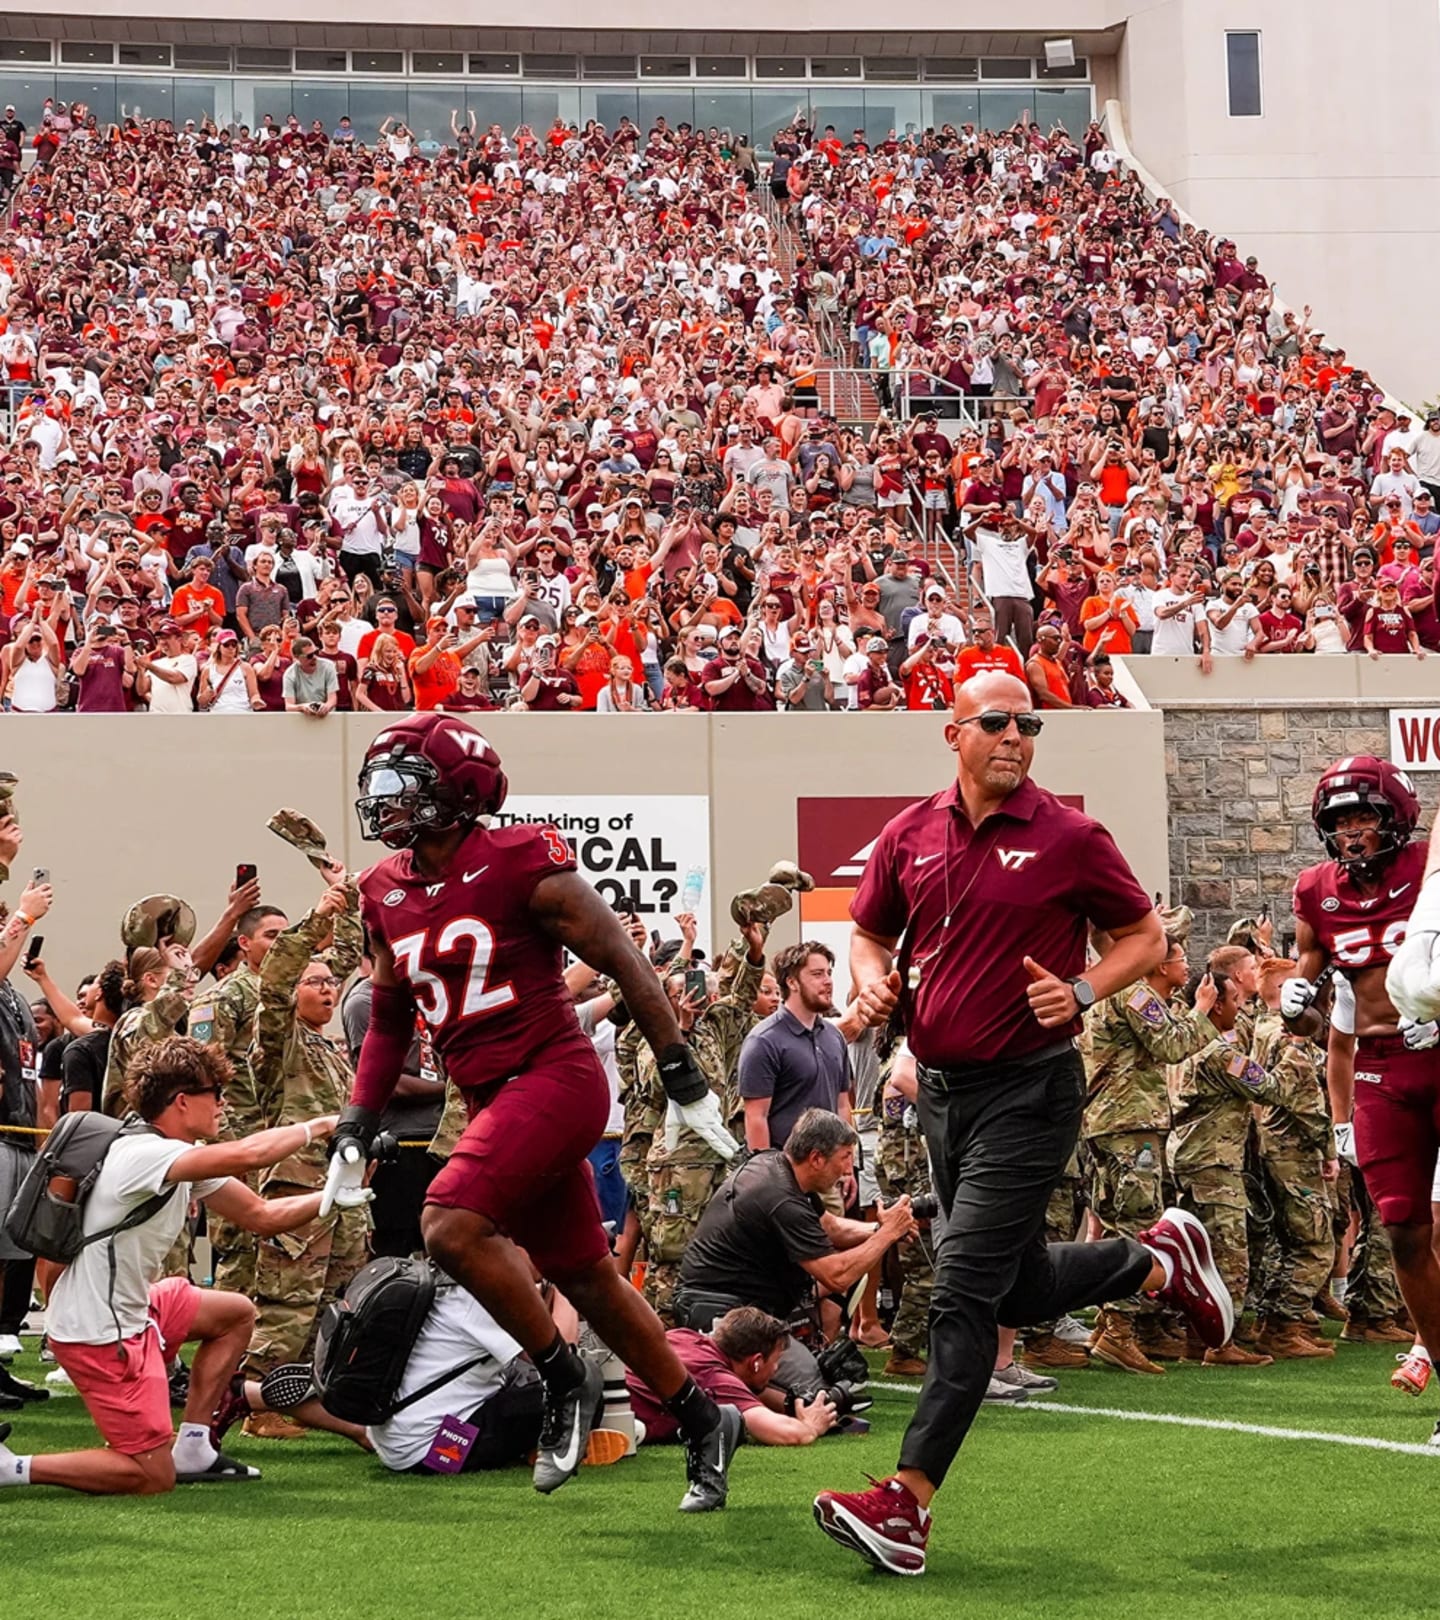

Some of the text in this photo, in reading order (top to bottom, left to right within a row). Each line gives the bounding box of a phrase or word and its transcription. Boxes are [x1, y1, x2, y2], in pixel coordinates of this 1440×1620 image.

[432, 526, 449, 546] 25
[540, 677, 567, 688] VT
[445, 728, 491, 758] VT
[496, 812, 634, 834] Thinking of
[566, 836, 677, 873] ICAL
[996, 847, 1038, 871] VT
[424, 881, 446, 897] VT
[594, 878, 679, 913] OL?
[390, 914, 519, 1027] 32
[441, 1429, 469, 1447] PHOTO
